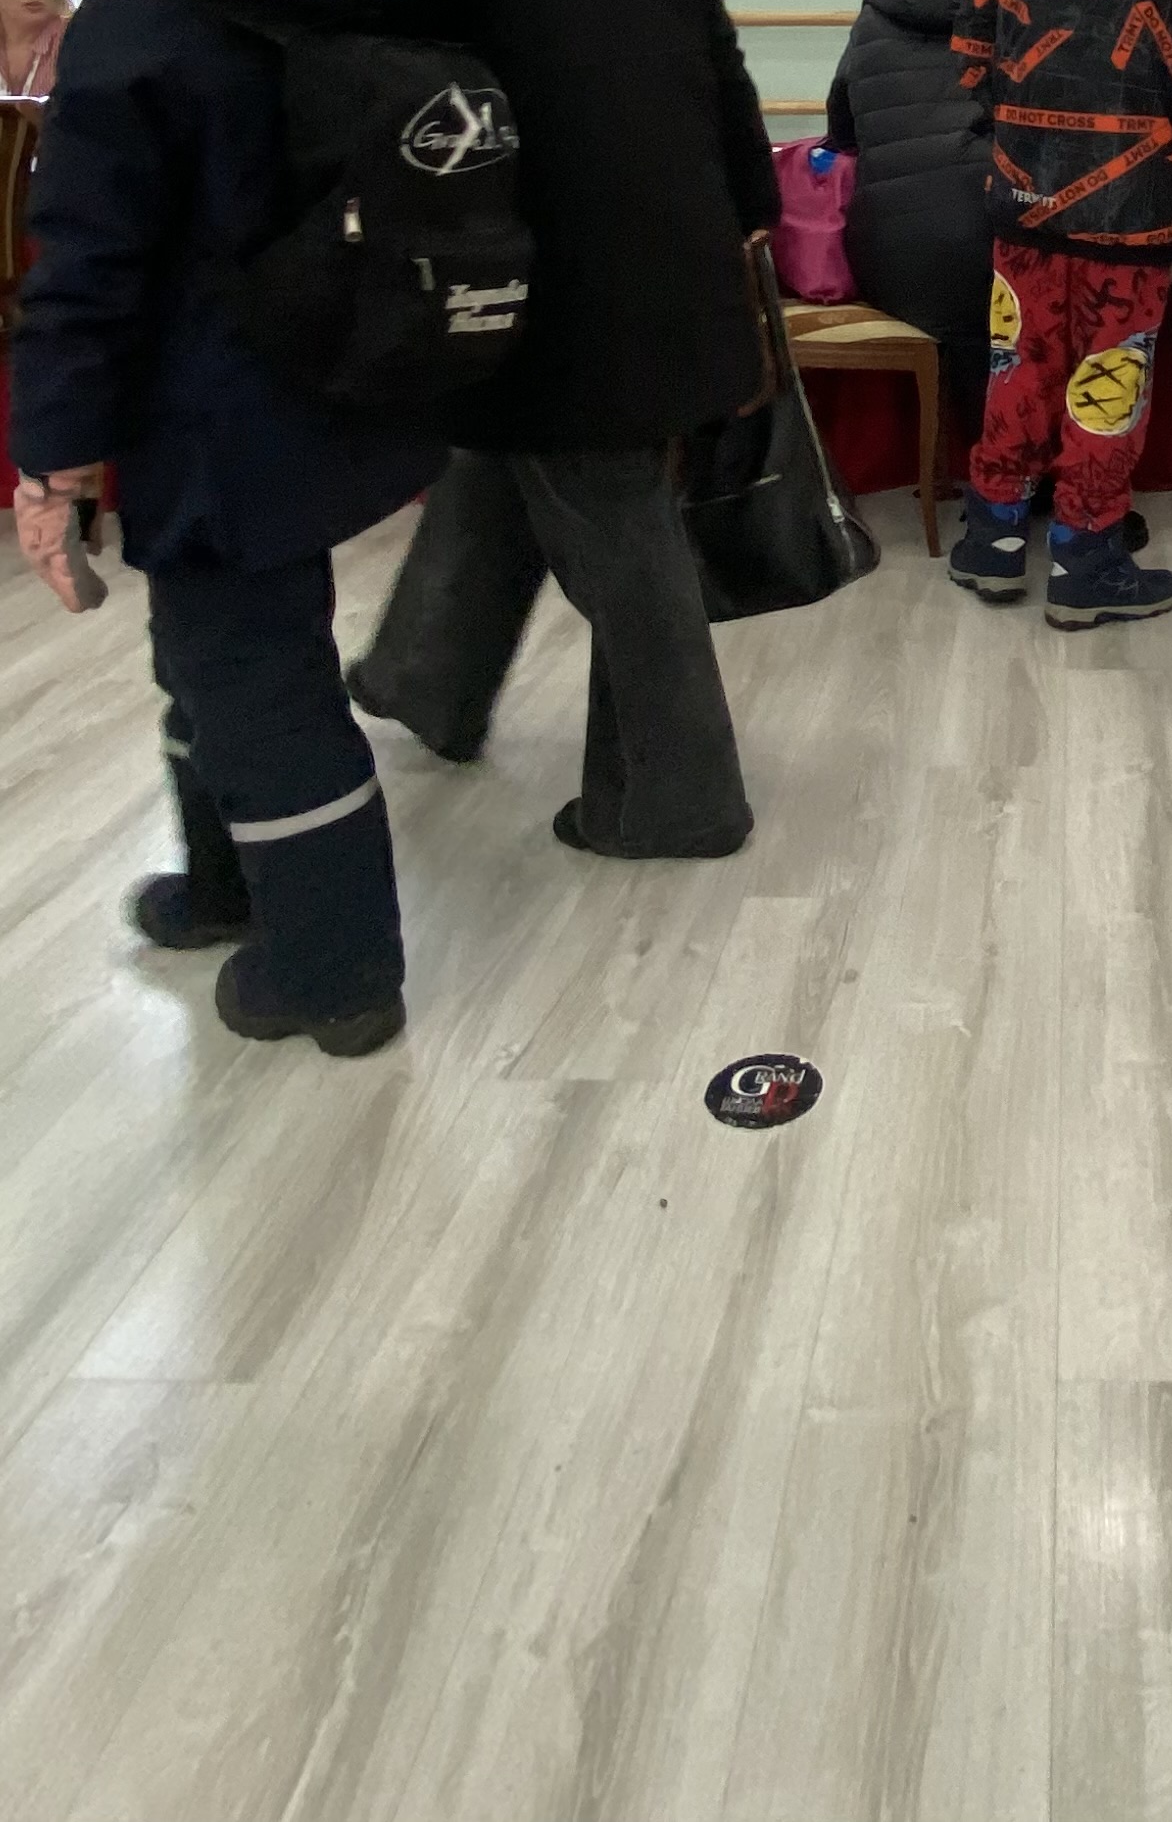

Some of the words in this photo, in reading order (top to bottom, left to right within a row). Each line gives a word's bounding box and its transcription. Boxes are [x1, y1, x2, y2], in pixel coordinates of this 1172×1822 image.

[1019, 111, 1044, 124] NOT
[1047, 112, 1095, 128] CROSS
[1118, 118, 1156, 131] TRMT
[1057, 182, 1086, 204] NOT
